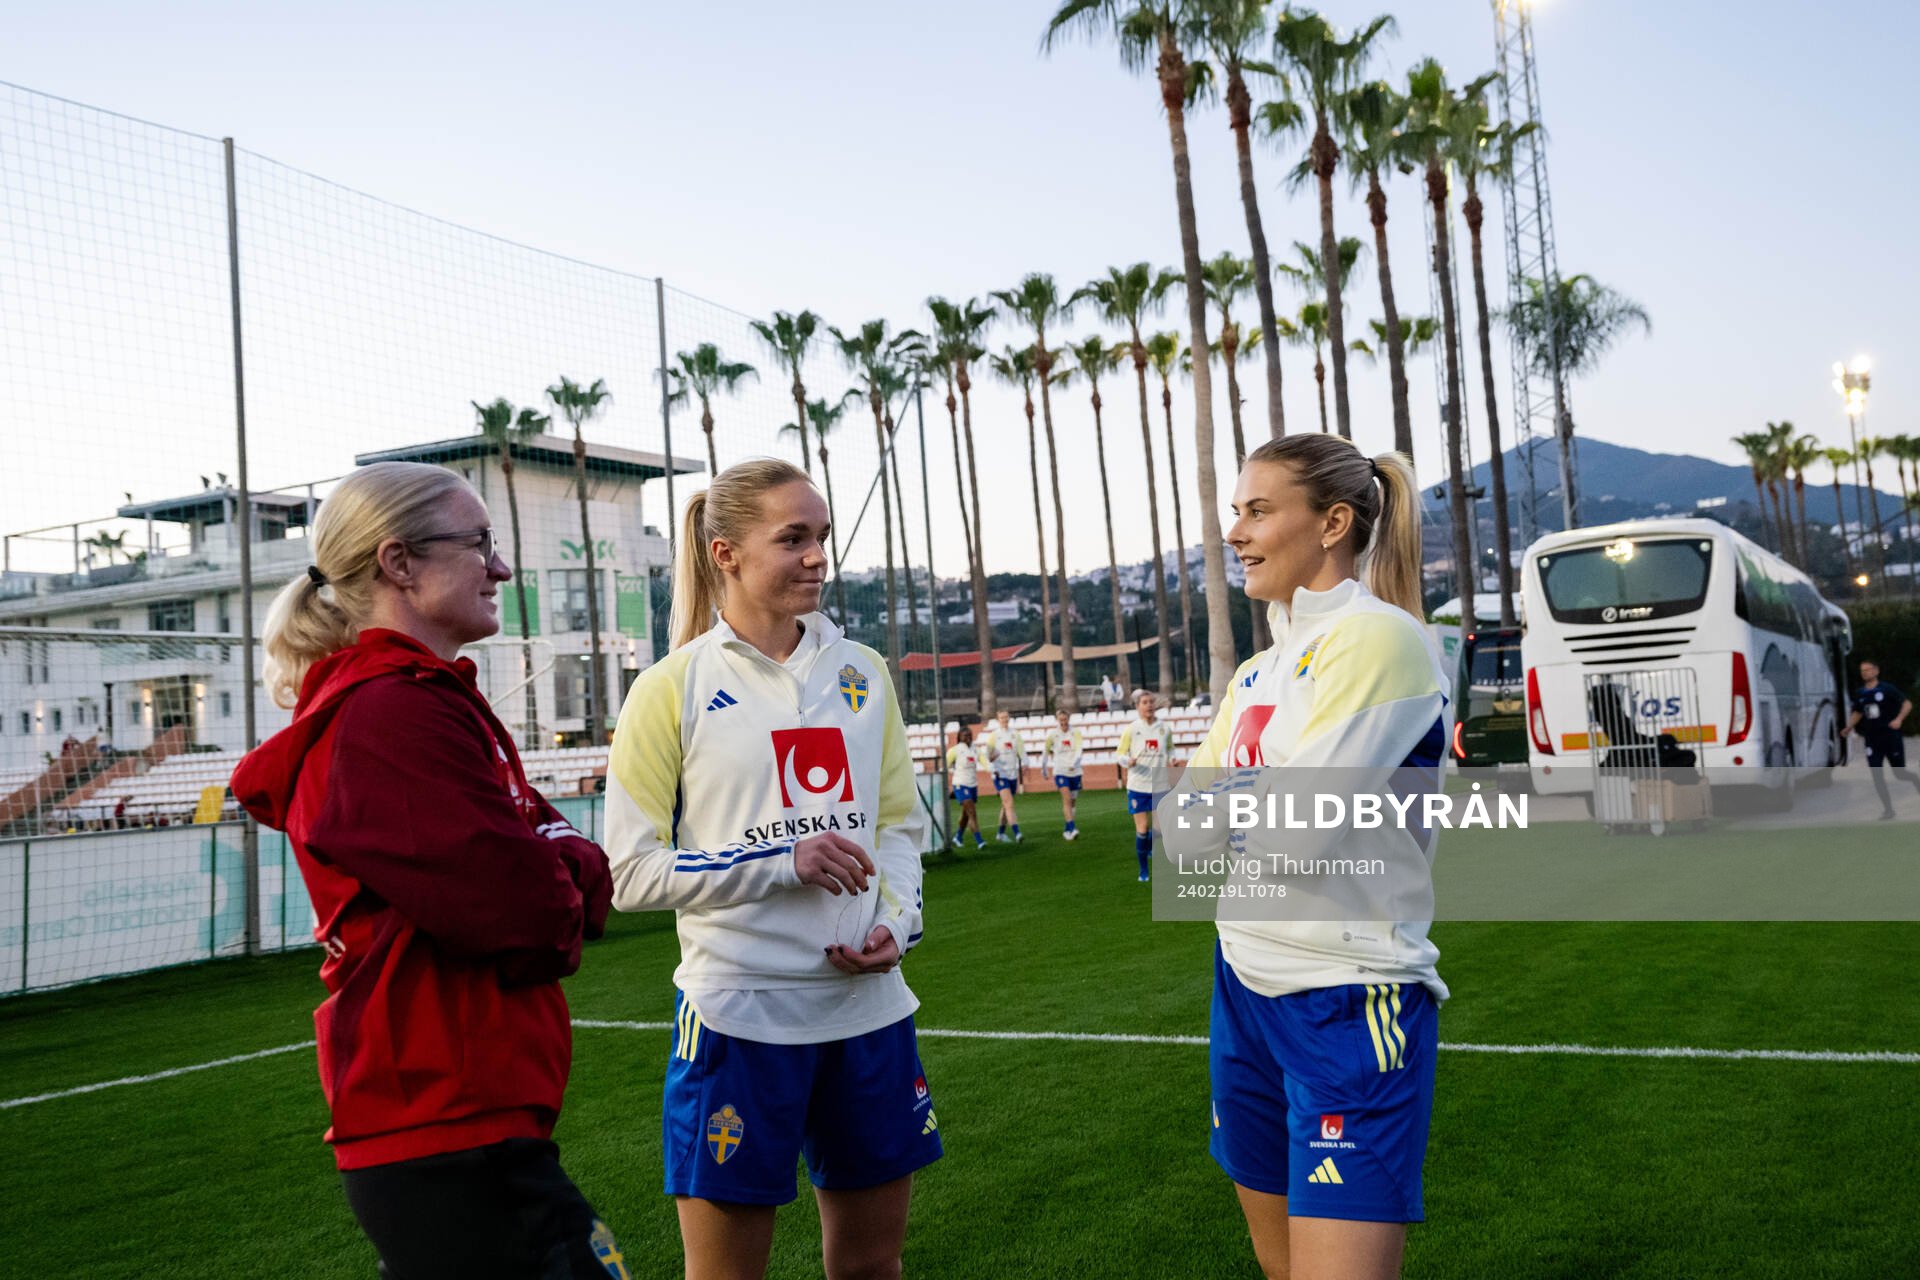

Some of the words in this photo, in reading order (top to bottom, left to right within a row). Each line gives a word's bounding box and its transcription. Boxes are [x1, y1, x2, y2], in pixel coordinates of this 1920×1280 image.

[744, 814, 841, 846] SVENSKA
[1309, 1141, 1338, 1149] SVENSKA
[1339, 1141, 1357, 1149] SPEL
